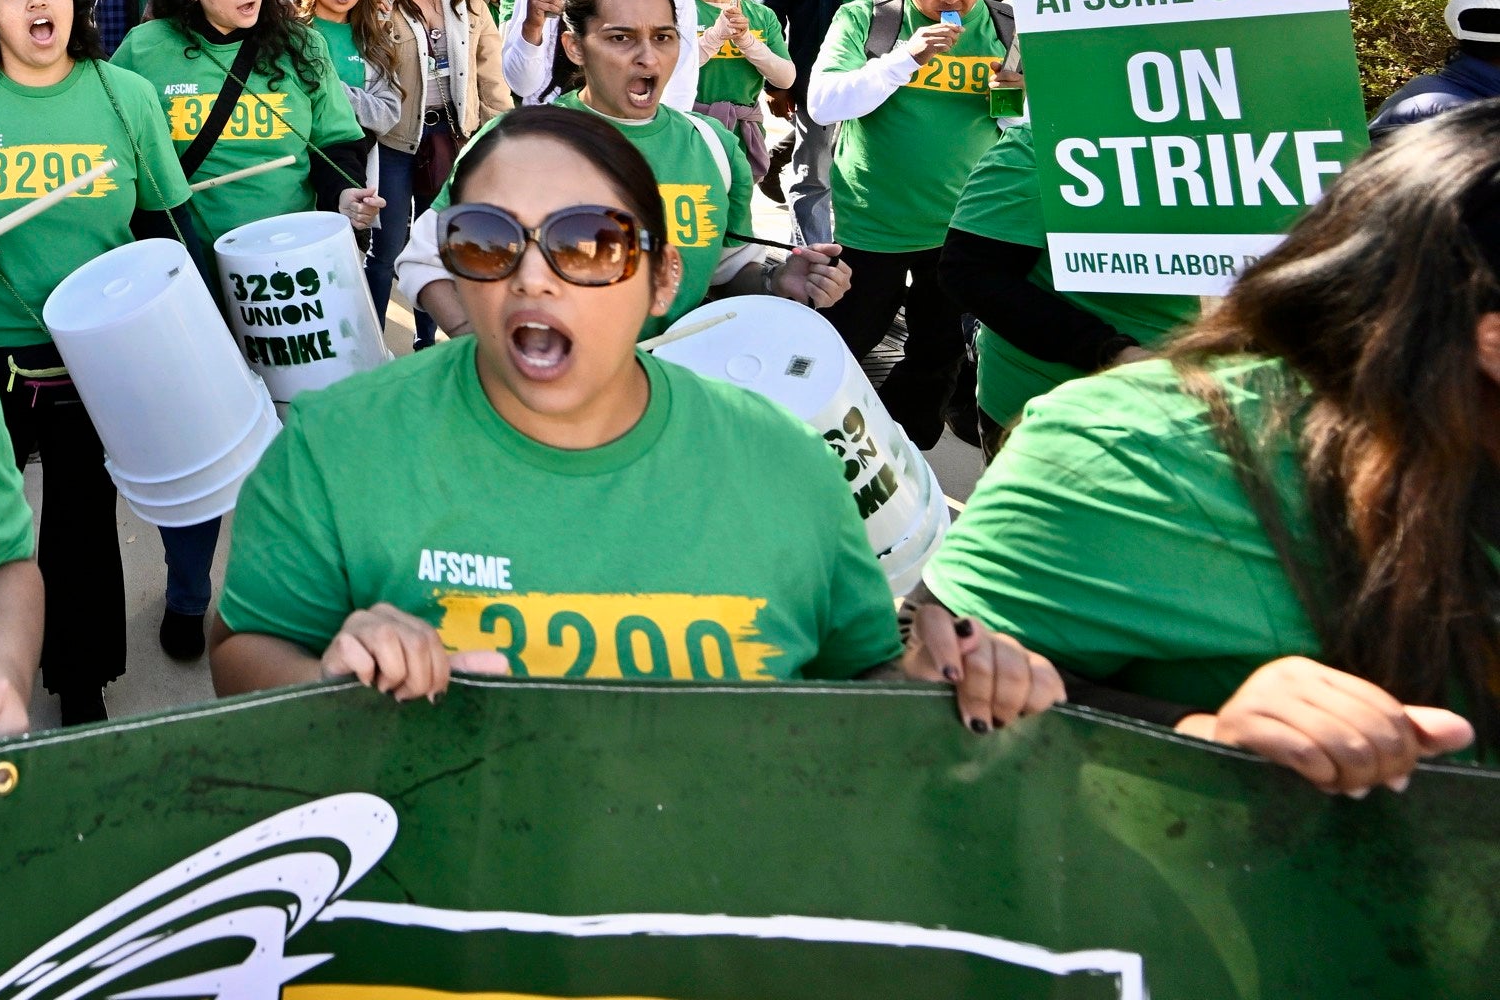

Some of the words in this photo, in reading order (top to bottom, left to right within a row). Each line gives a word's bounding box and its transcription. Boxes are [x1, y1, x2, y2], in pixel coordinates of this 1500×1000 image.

[164, 83, 198, 95] AFSCME
[1126, 47, 1242, 123] ON
[1065, 251, 1148, 274] UNFAIR
[1156, 253, 1238, 276] LABOR
[229, 267, 321, 302] 3299
[240, 300, 325, 327] UNION
[244, 330, 337, 367] STRIKE
[418, 548, 512, 590] AFSCME
